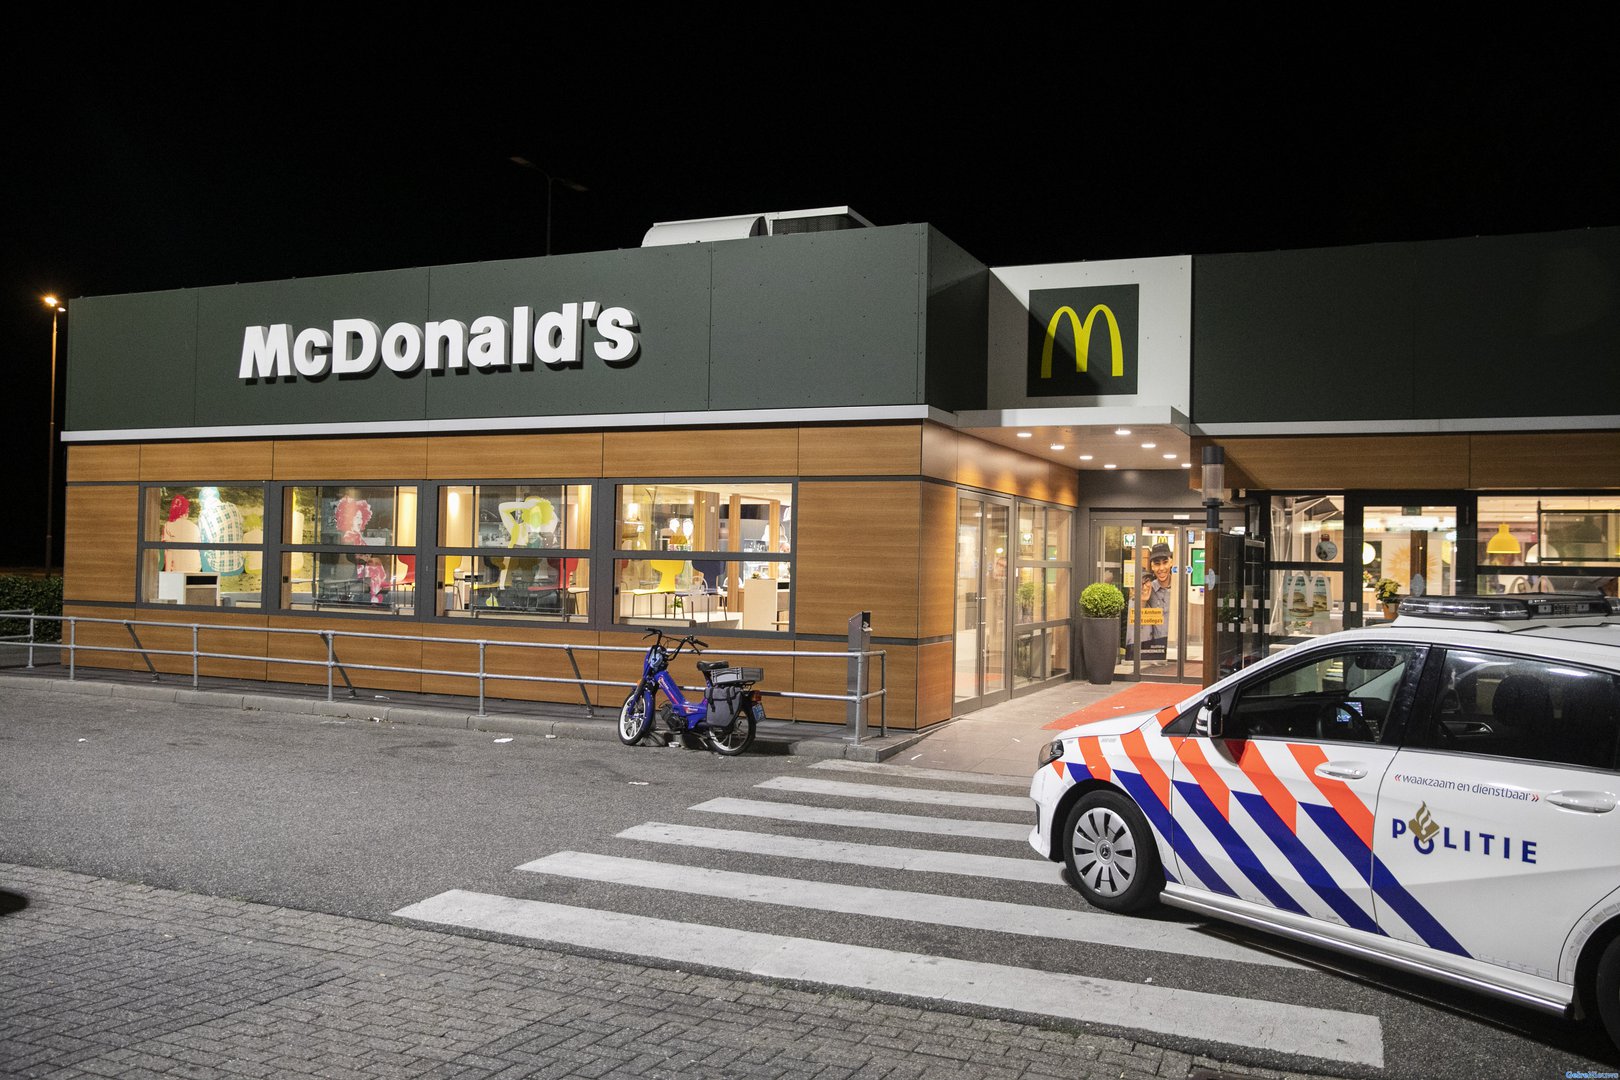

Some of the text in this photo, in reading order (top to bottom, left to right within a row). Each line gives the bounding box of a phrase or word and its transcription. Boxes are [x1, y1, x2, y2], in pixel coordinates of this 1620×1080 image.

[238, 301, 640, 379] McDonald's
[1457, 781, 1470, 792] en
[1392, 817, 1537, 864] POLITIE
